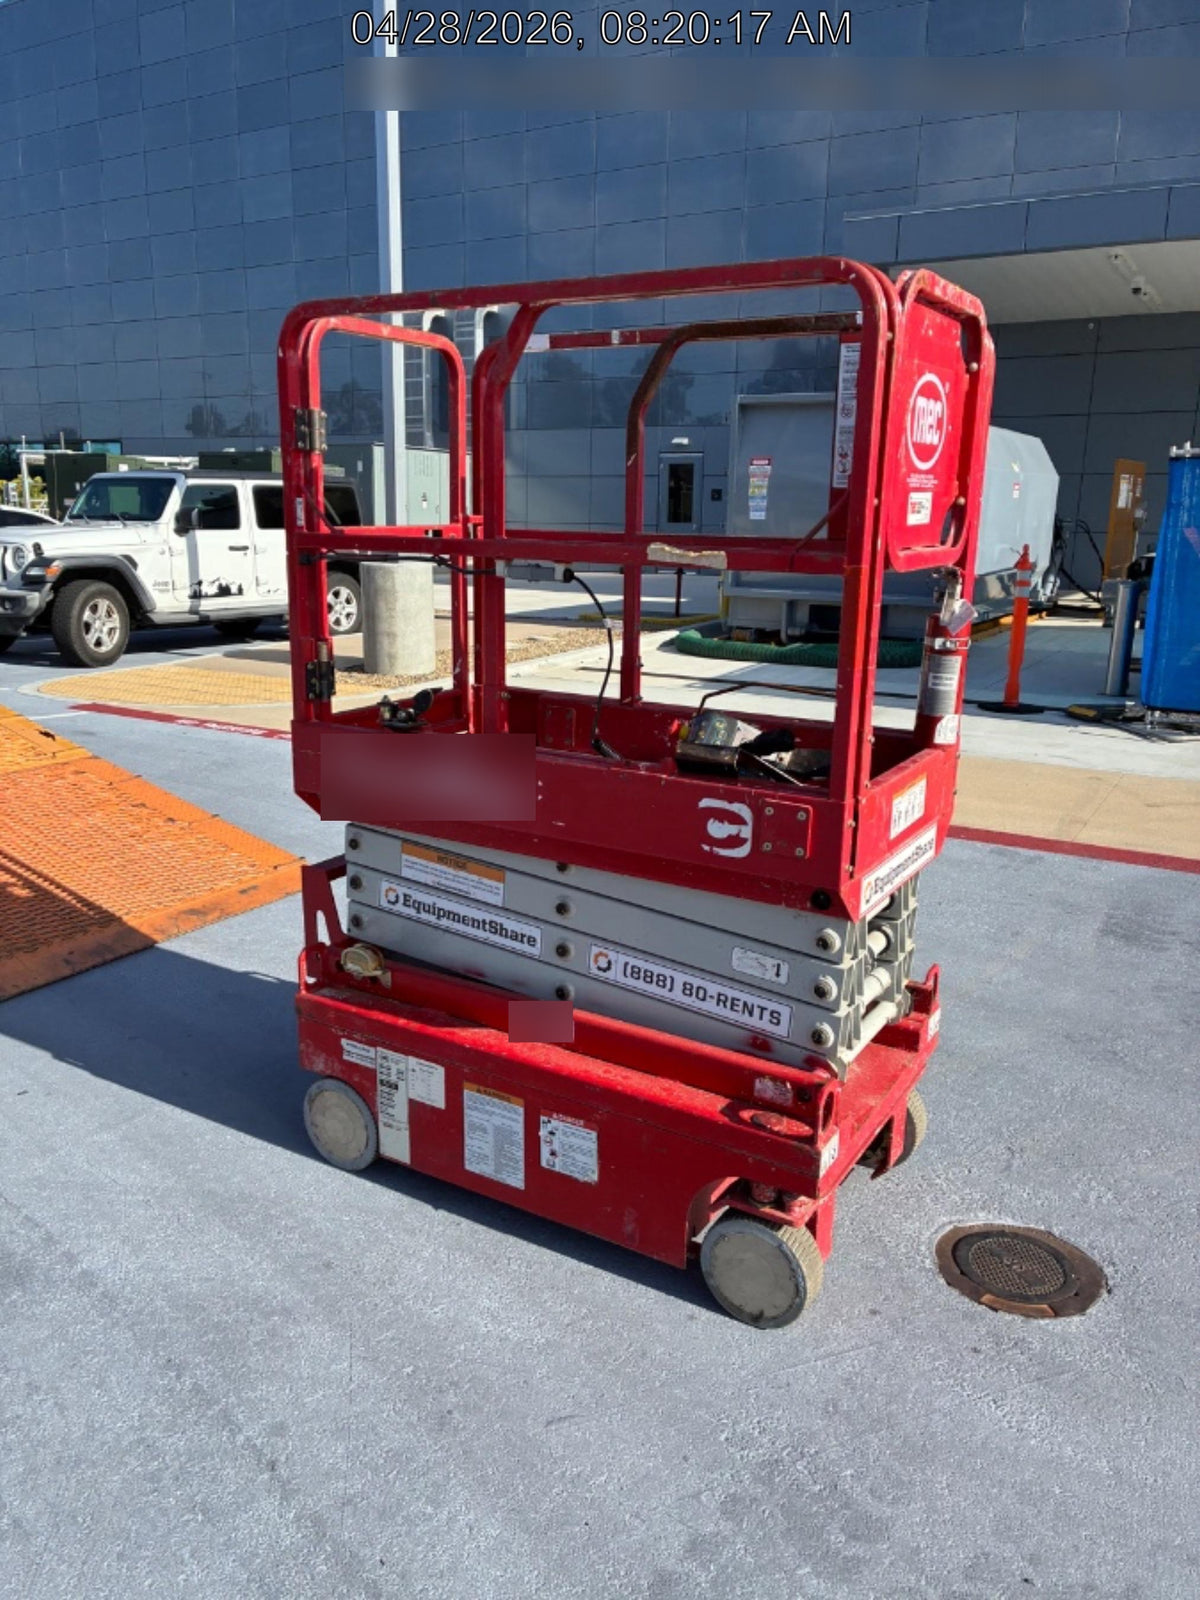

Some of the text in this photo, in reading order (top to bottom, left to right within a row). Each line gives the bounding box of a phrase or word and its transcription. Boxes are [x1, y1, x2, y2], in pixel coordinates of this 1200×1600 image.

[402, 892, 537, 948] EquipmentShare
[622, 961, 782, 1027] (888) 80-RENTS
